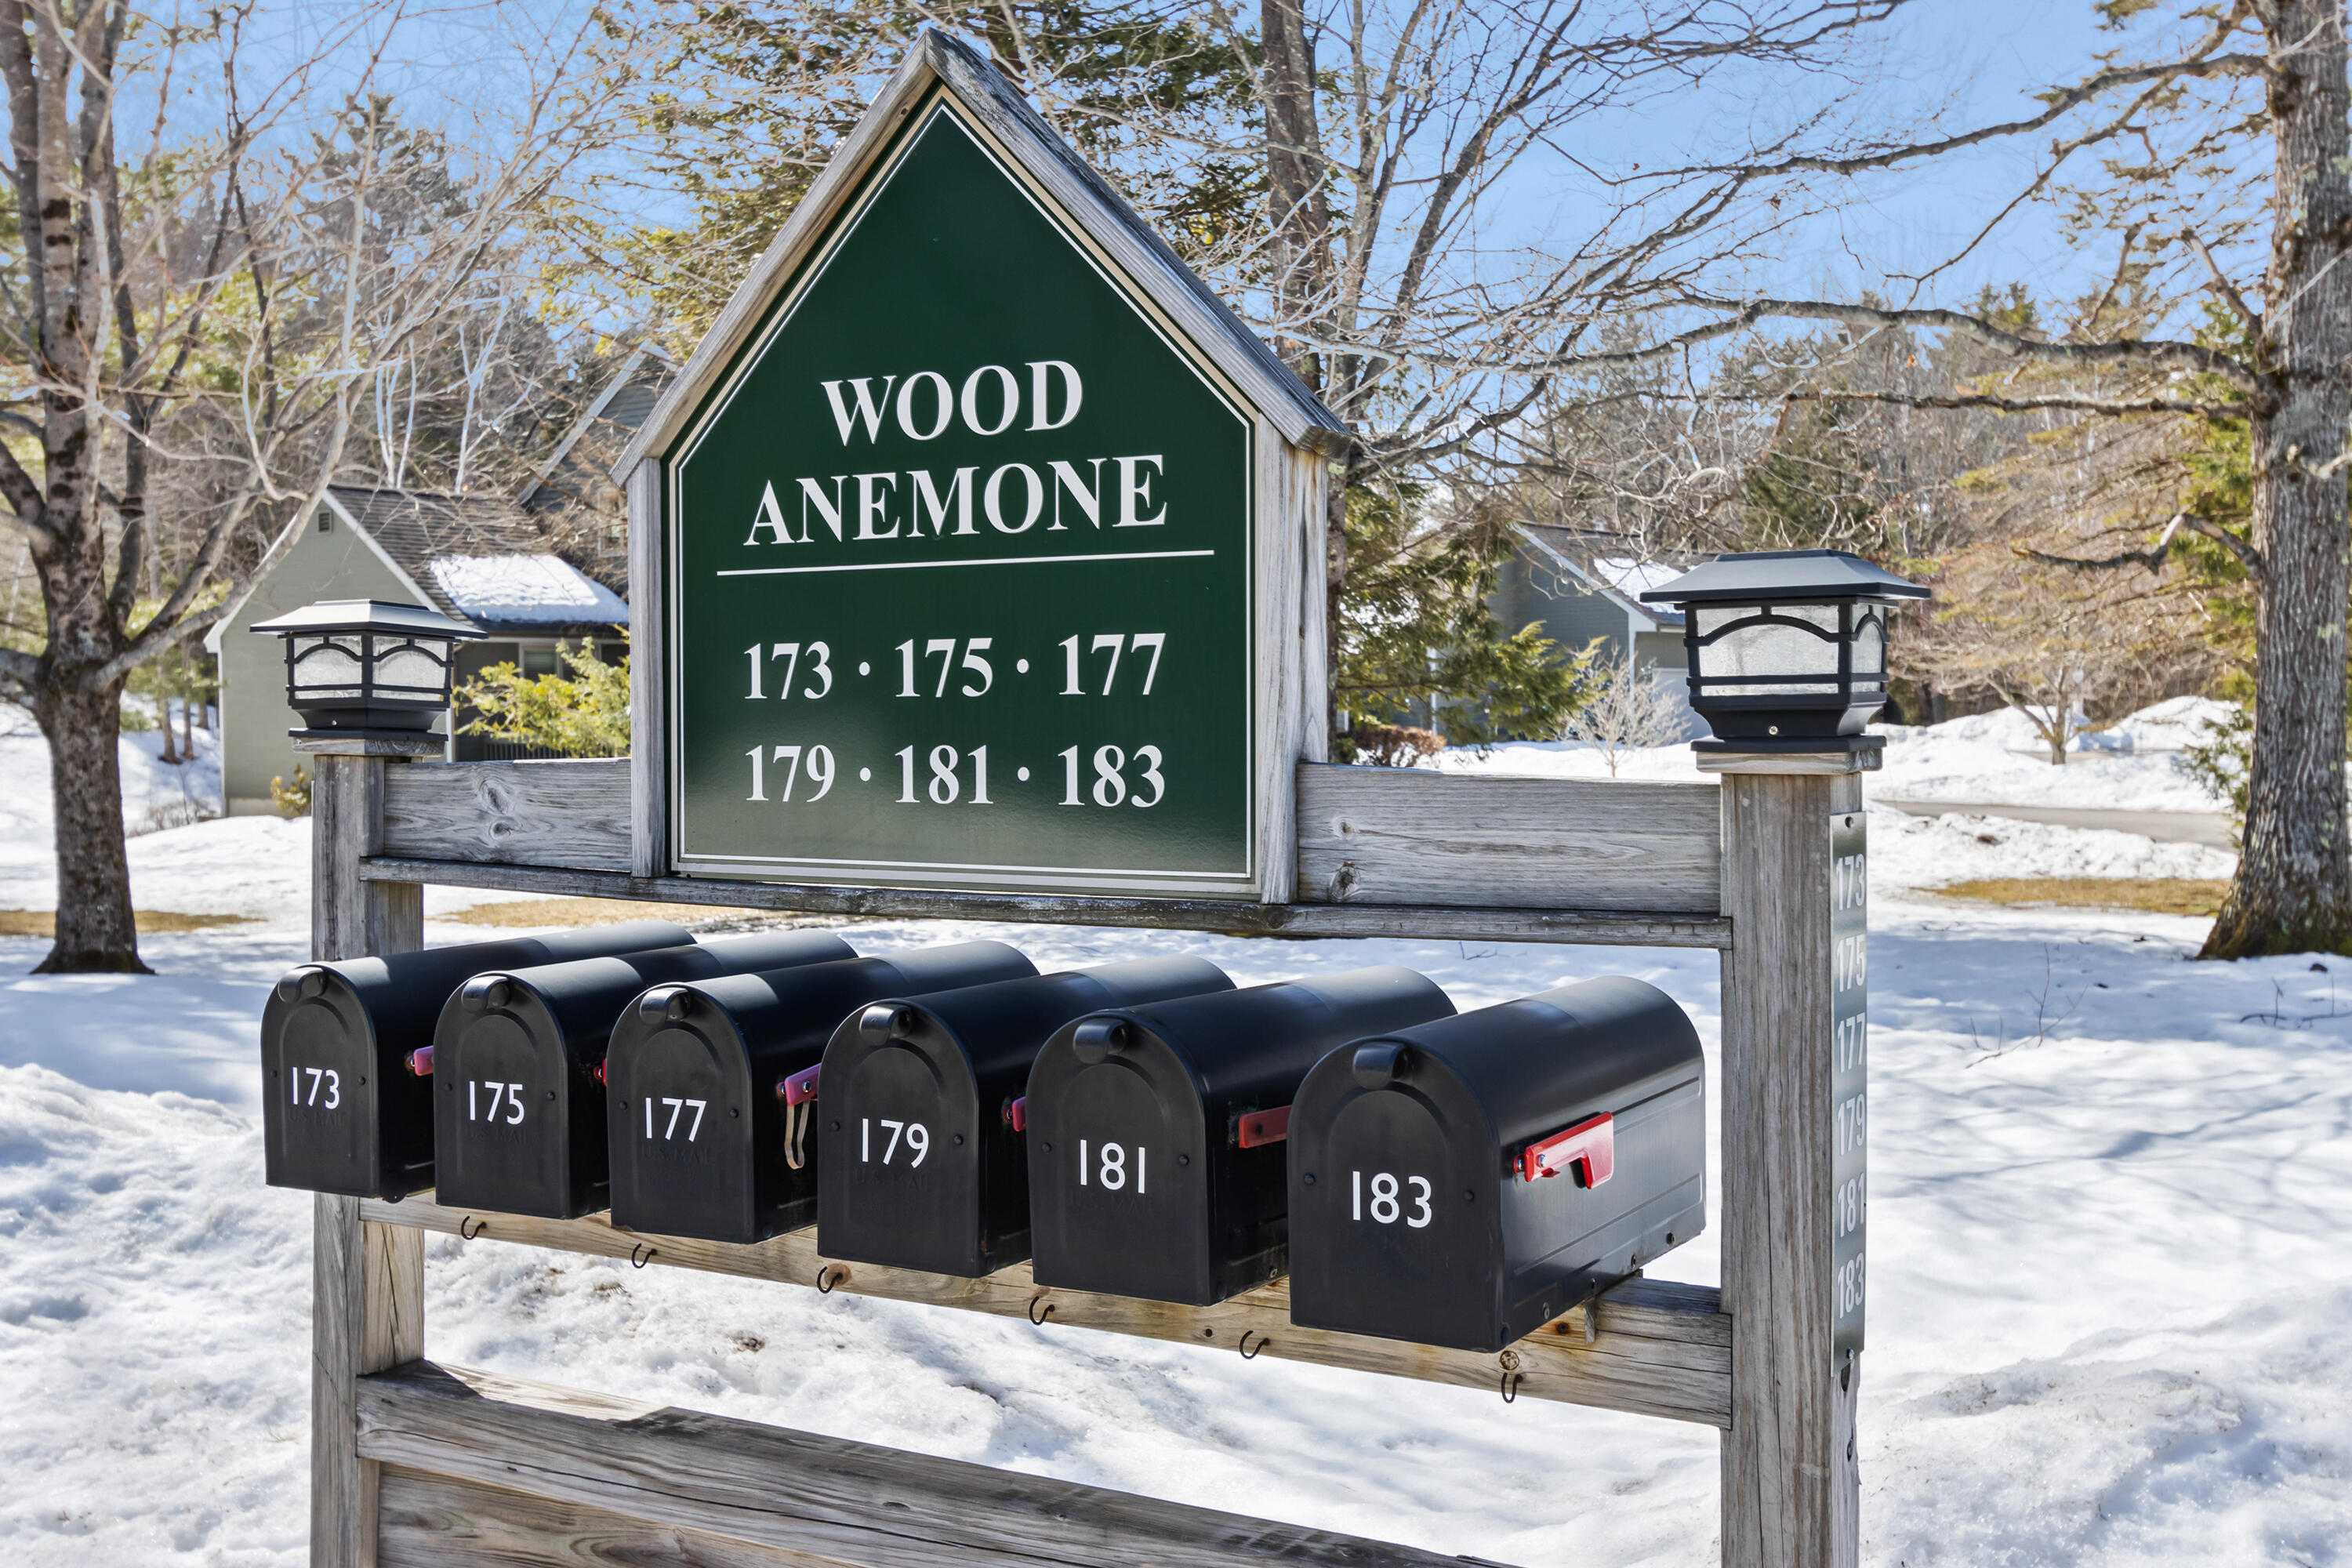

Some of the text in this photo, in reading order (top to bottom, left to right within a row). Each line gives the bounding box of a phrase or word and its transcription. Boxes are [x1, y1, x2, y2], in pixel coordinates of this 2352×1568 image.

[820, 360, 1083, 446] WOOD
[742, 454, 1167, 546] ANEMONE
[744, 633, 1166, 700] 173 175 177
[745, 744, 1165, 808] 179 181 183
[1837, 854, 1865, 911] 173
[1837, 935, 1865, 993] 175
[1837, 1013, 1866, 1073] 177
[292, 1066, 340, 1109] 173
[469, 1080, 524, 1125] 175
[645, 1097, 707, 1142] 177
[862, 1118, 929, 1169] 179
[1837, 1093, 1865, 1156] 179
[1080, 1139, 1145, 1194] 181
[1352, 1171, 1432, 1229] 183
[1837, 1171, 1865, 1239] 181
[1838, 1252, 1864, 1319] 183
